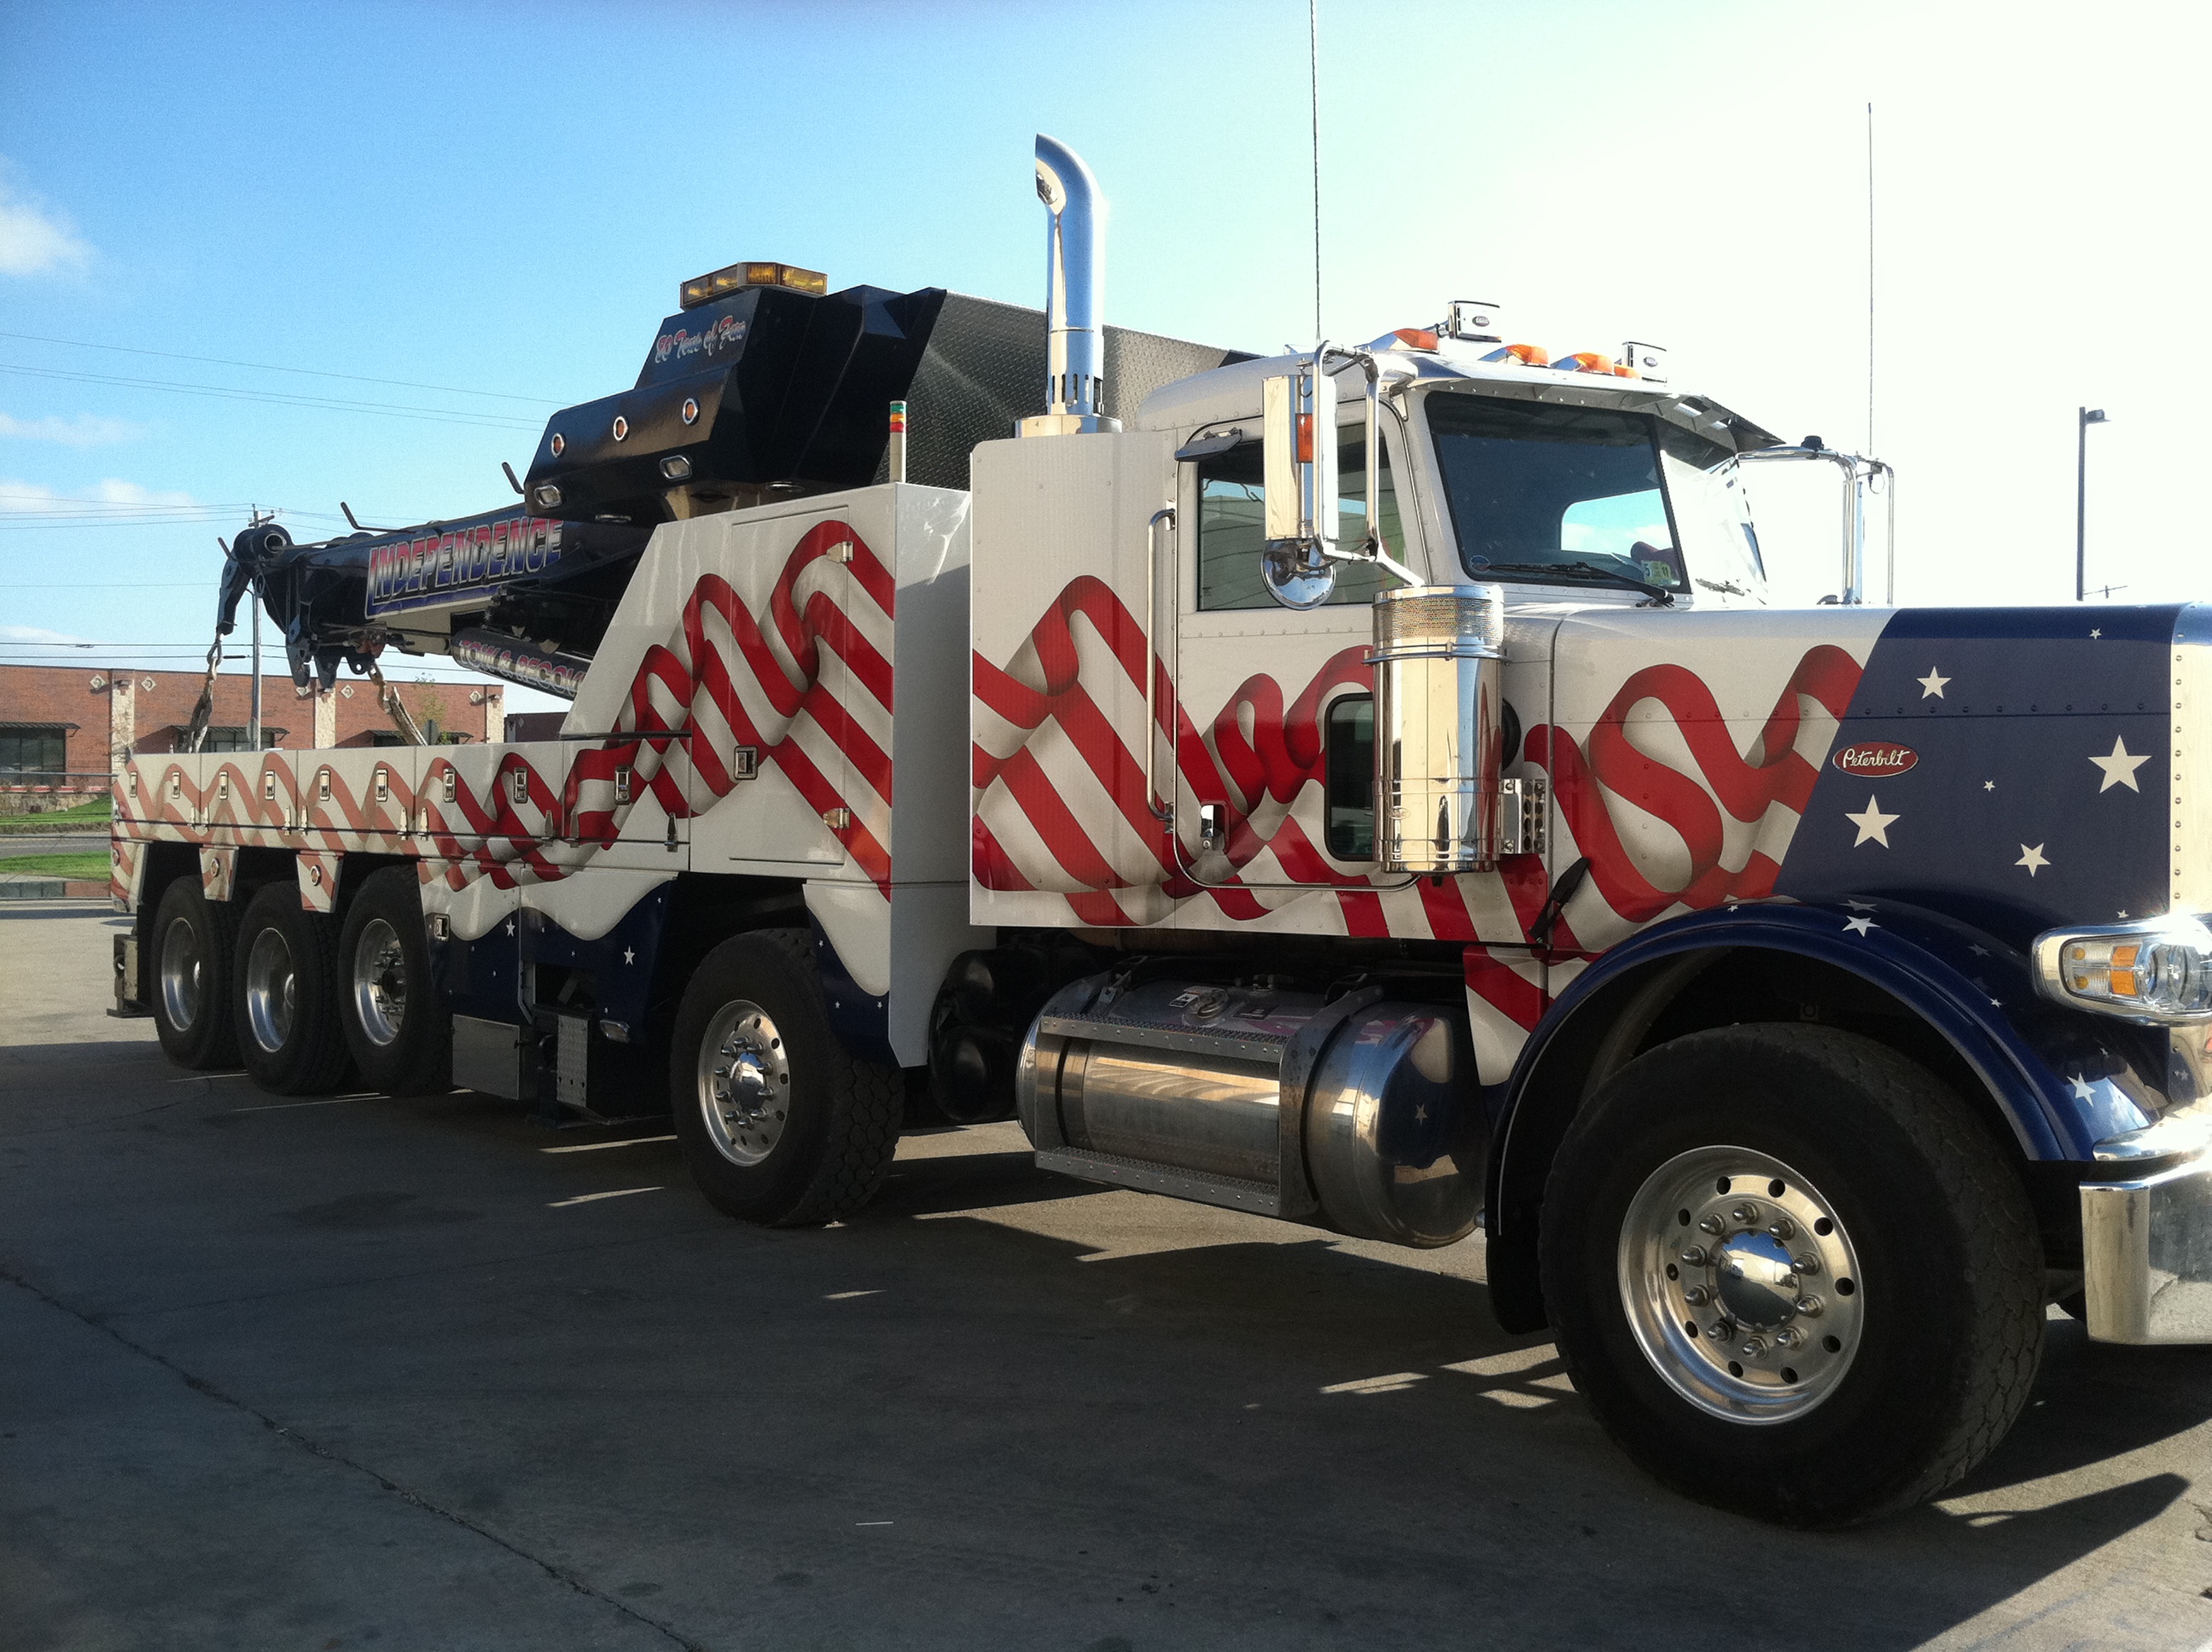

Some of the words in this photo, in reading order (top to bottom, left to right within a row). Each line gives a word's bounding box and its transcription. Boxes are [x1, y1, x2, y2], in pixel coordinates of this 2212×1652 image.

[673, 329, 702, 358] Tons
[703, 320, 718, 357] of
[367, 516, 563, 600] INDEPENDENCE
[458, 640, 501, 672] TOW
[497, 649, 514, 678] &
[514, 654, 589, 697] RECOV
[1842, 747, 1911, 769] Peterbilt
